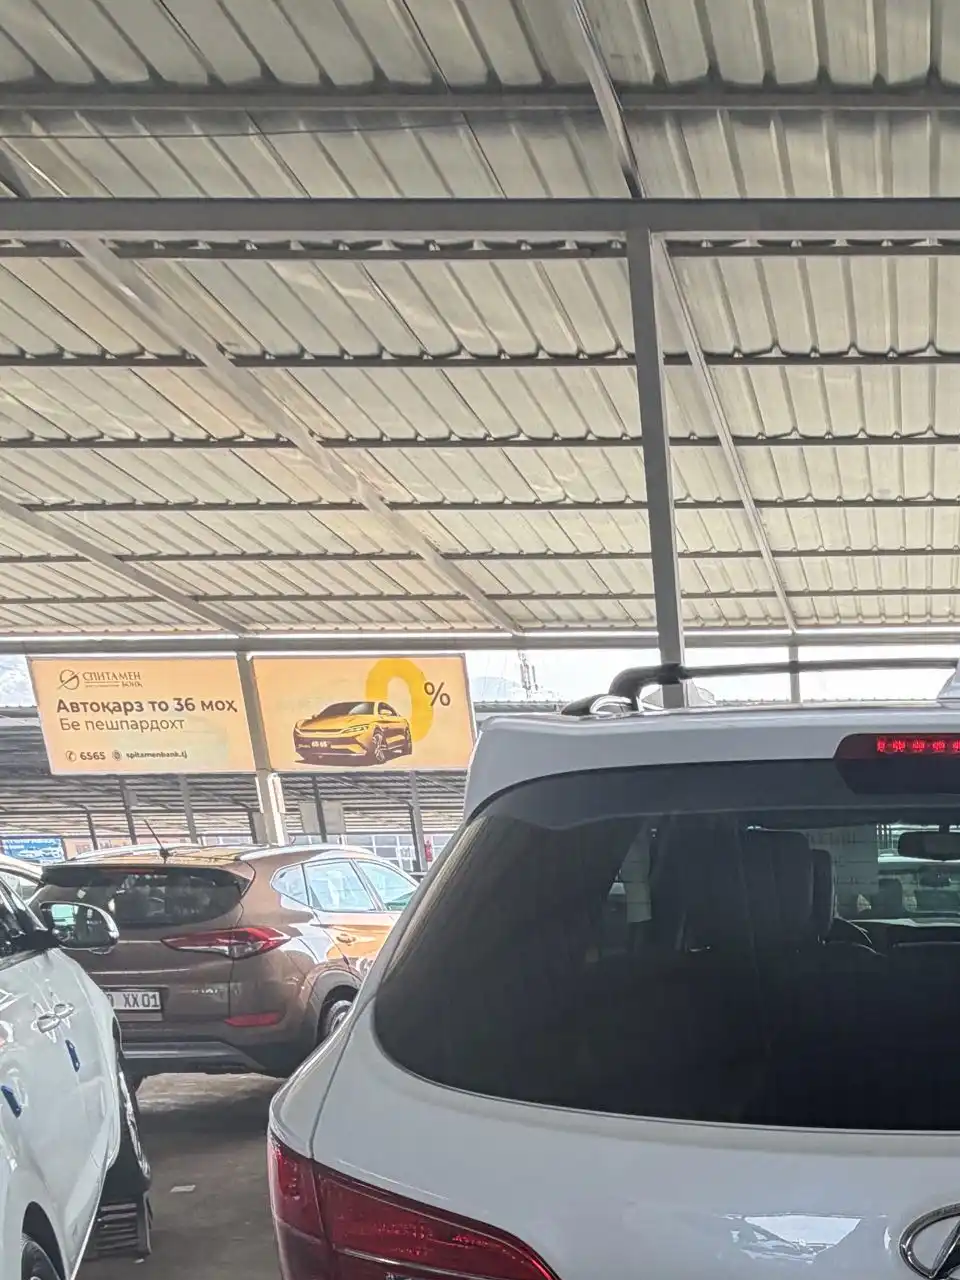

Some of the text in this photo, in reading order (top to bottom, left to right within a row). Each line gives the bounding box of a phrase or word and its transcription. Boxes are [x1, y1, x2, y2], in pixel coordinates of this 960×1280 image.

[82, 671, 142, 681] СПИТАМЕН
[56, 699, 144, 716] Автоқарз
[148, 701, 169, 712] то
[172, 697, 196, 712] 36
[59, 718, 185, 733] Бе пешпардохт
[79, 750, 188, 761] 6565 spitamenbank.tj
